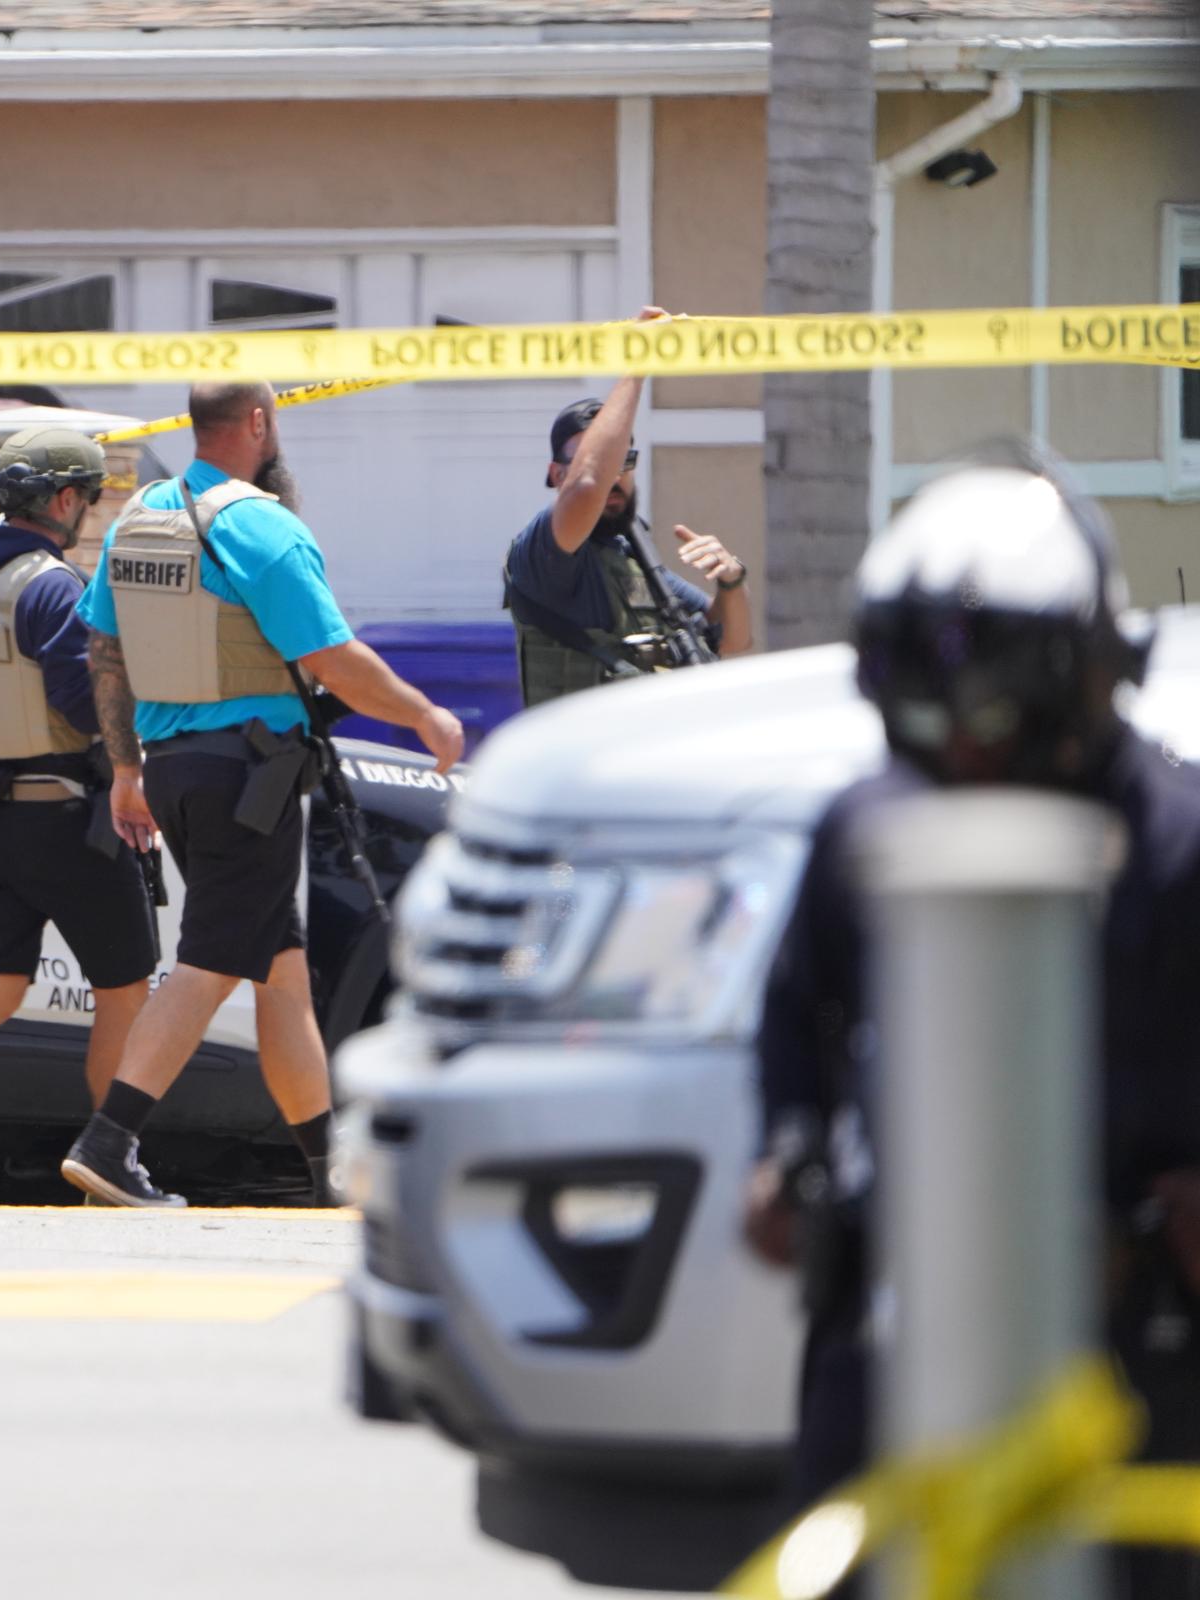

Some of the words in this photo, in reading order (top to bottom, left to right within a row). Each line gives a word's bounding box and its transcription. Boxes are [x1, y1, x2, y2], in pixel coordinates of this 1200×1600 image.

[111, 557, 188, 588] SHERIFF
[356, 759, 449, 792] DIEGO
[39, 957, 70, 981] TO
[46, 986, 96, 1013] AND
